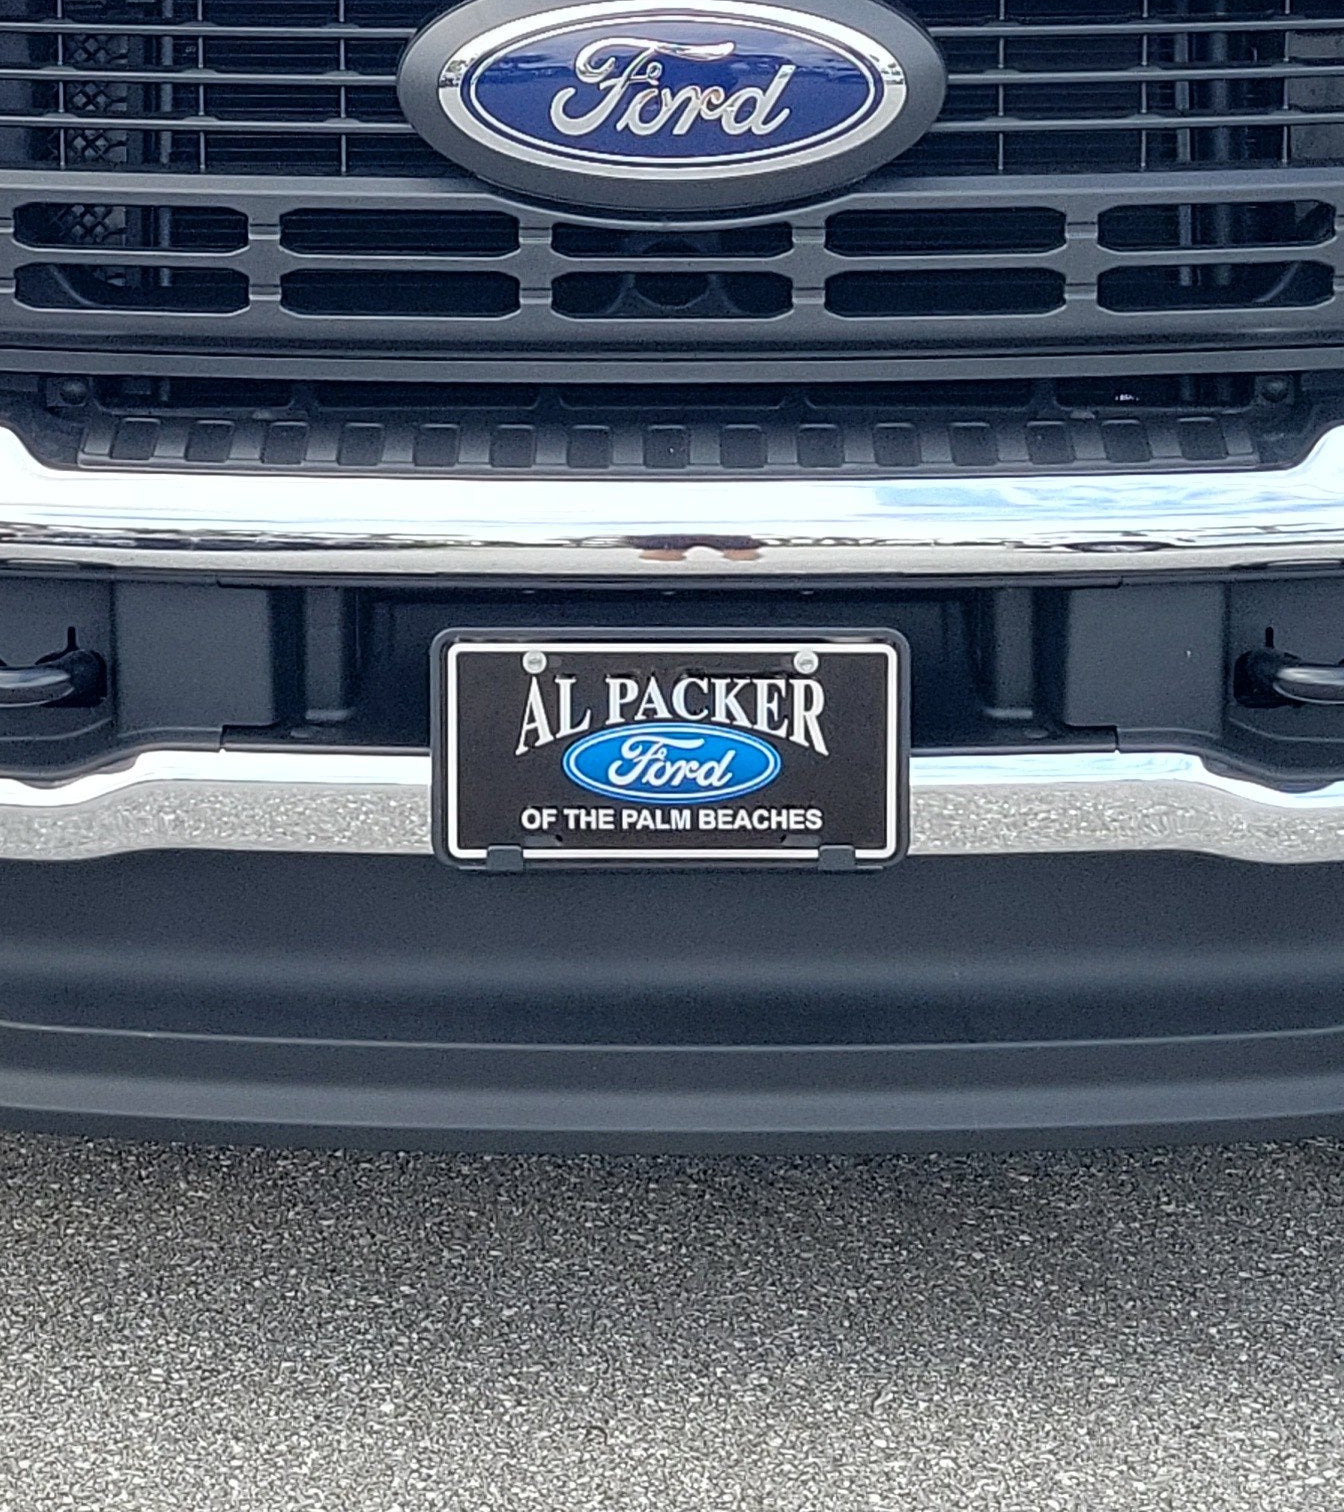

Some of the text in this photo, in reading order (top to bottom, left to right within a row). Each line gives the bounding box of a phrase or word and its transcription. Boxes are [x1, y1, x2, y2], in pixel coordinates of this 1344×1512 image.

[550, 36, 796, 137] Ford
[515, 675, 829, 756] AL PACKER
[607, 736, 737, 788] Ford
[521, 808, 823, 830] OF THE PALM BEACHES
